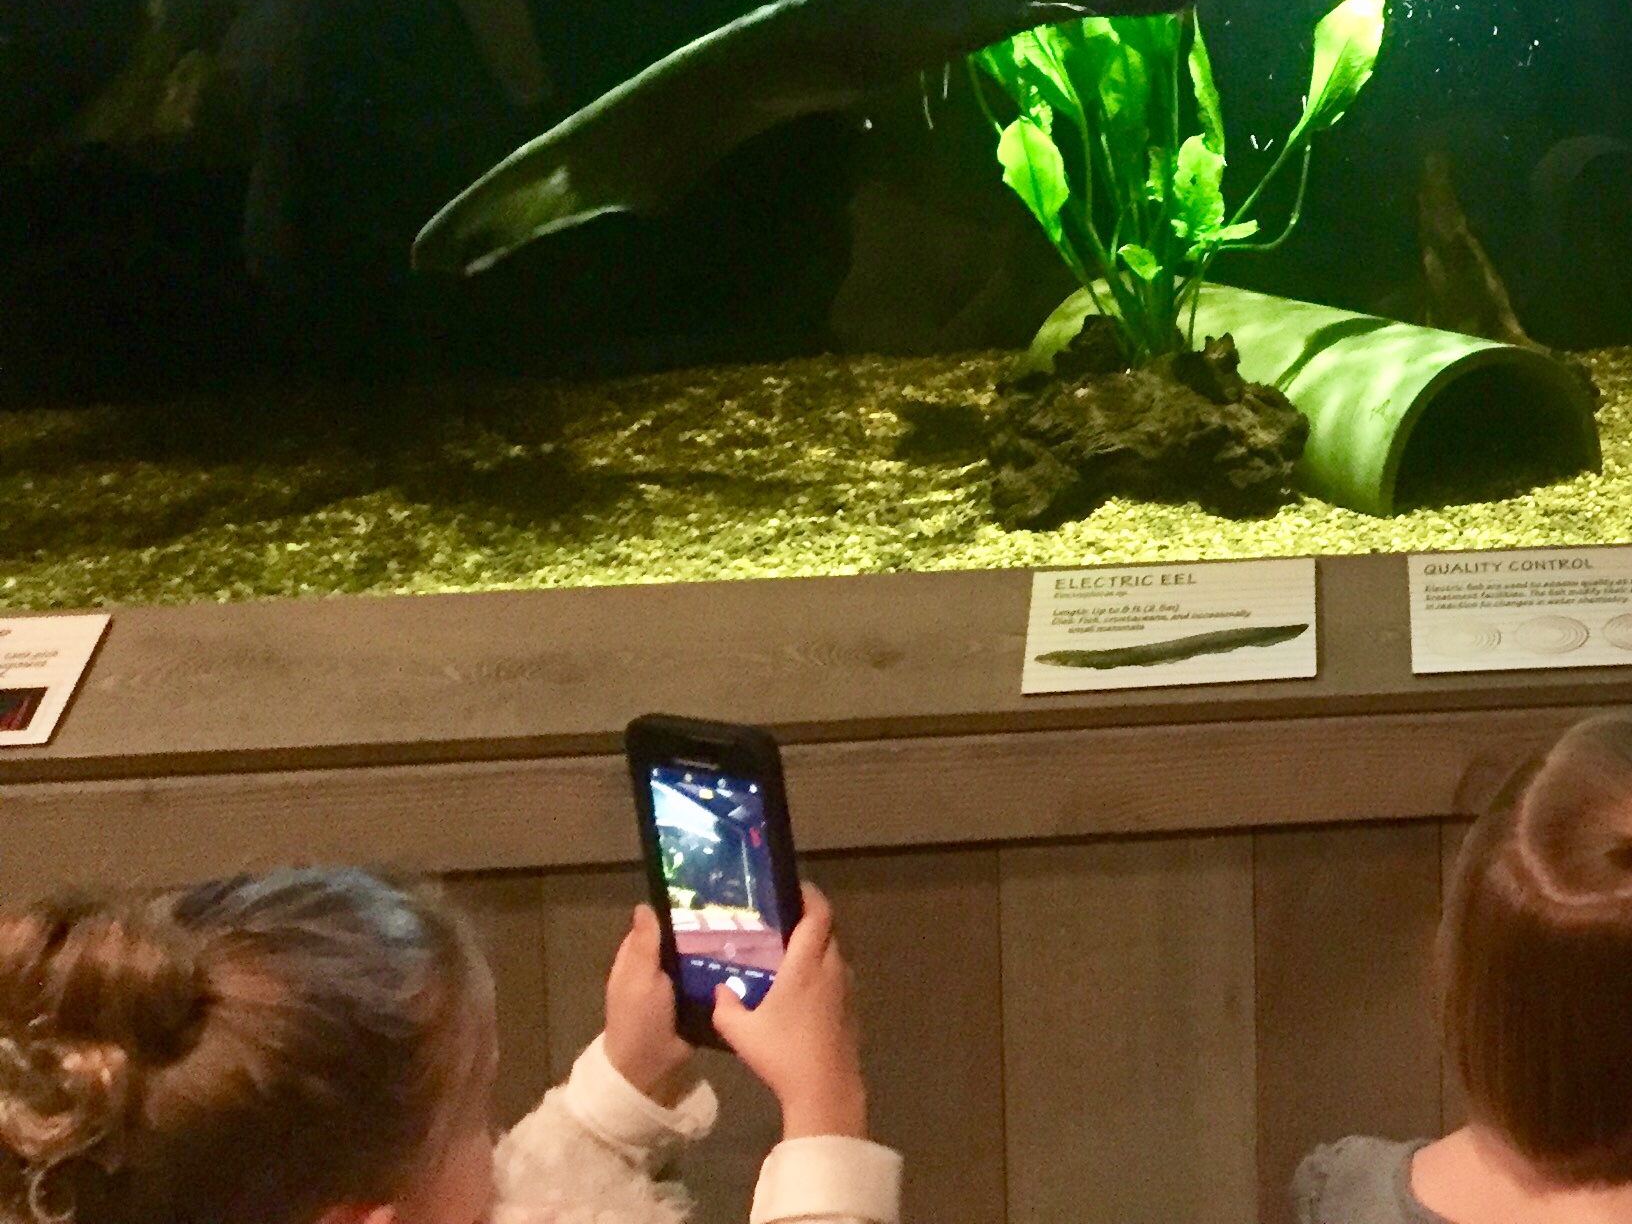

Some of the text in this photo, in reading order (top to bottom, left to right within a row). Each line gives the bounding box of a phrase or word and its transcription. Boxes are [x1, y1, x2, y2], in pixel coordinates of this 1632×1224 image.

[1423, 558, 1594, 575] QUALITY CONTROL
[1054, 573, 1197, 590] ELECTRIC EEL
